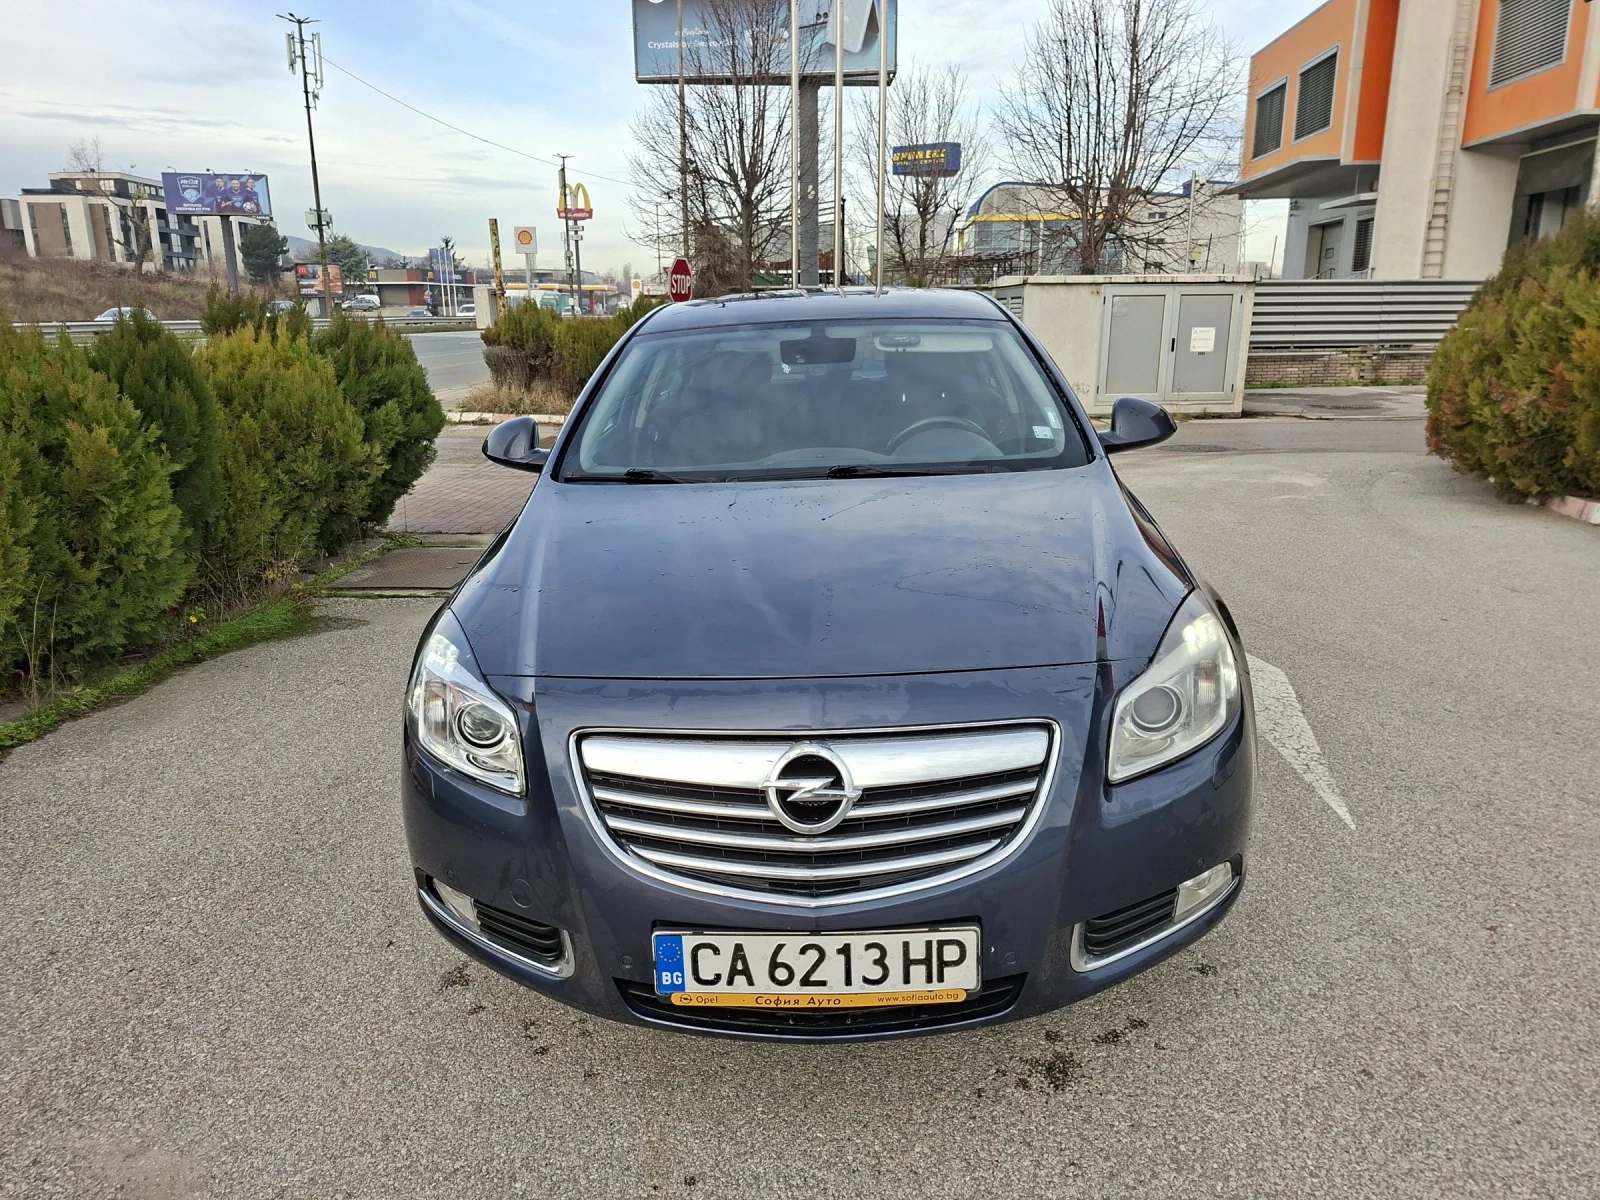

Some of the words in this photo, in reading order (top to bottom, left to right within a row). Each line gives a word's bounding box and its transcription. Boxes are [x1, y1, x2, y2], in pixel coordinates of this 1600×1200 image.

[647, 41, 679, 50] Crystals
[671, 274, 691, 294] STOP
[690, 942, 756, 987] CA
[768, 941, 890, 987] 6213
[902, 938, 967, 984] HP
[661, 971, 683, 985] BG
[696, 994, 718, 1005] Opel
[755, 995, 800, 1007] София
[807, 996, 841, 1007] Ауто
[877, 992, 959, 1003] www.sofiaauto.bg
